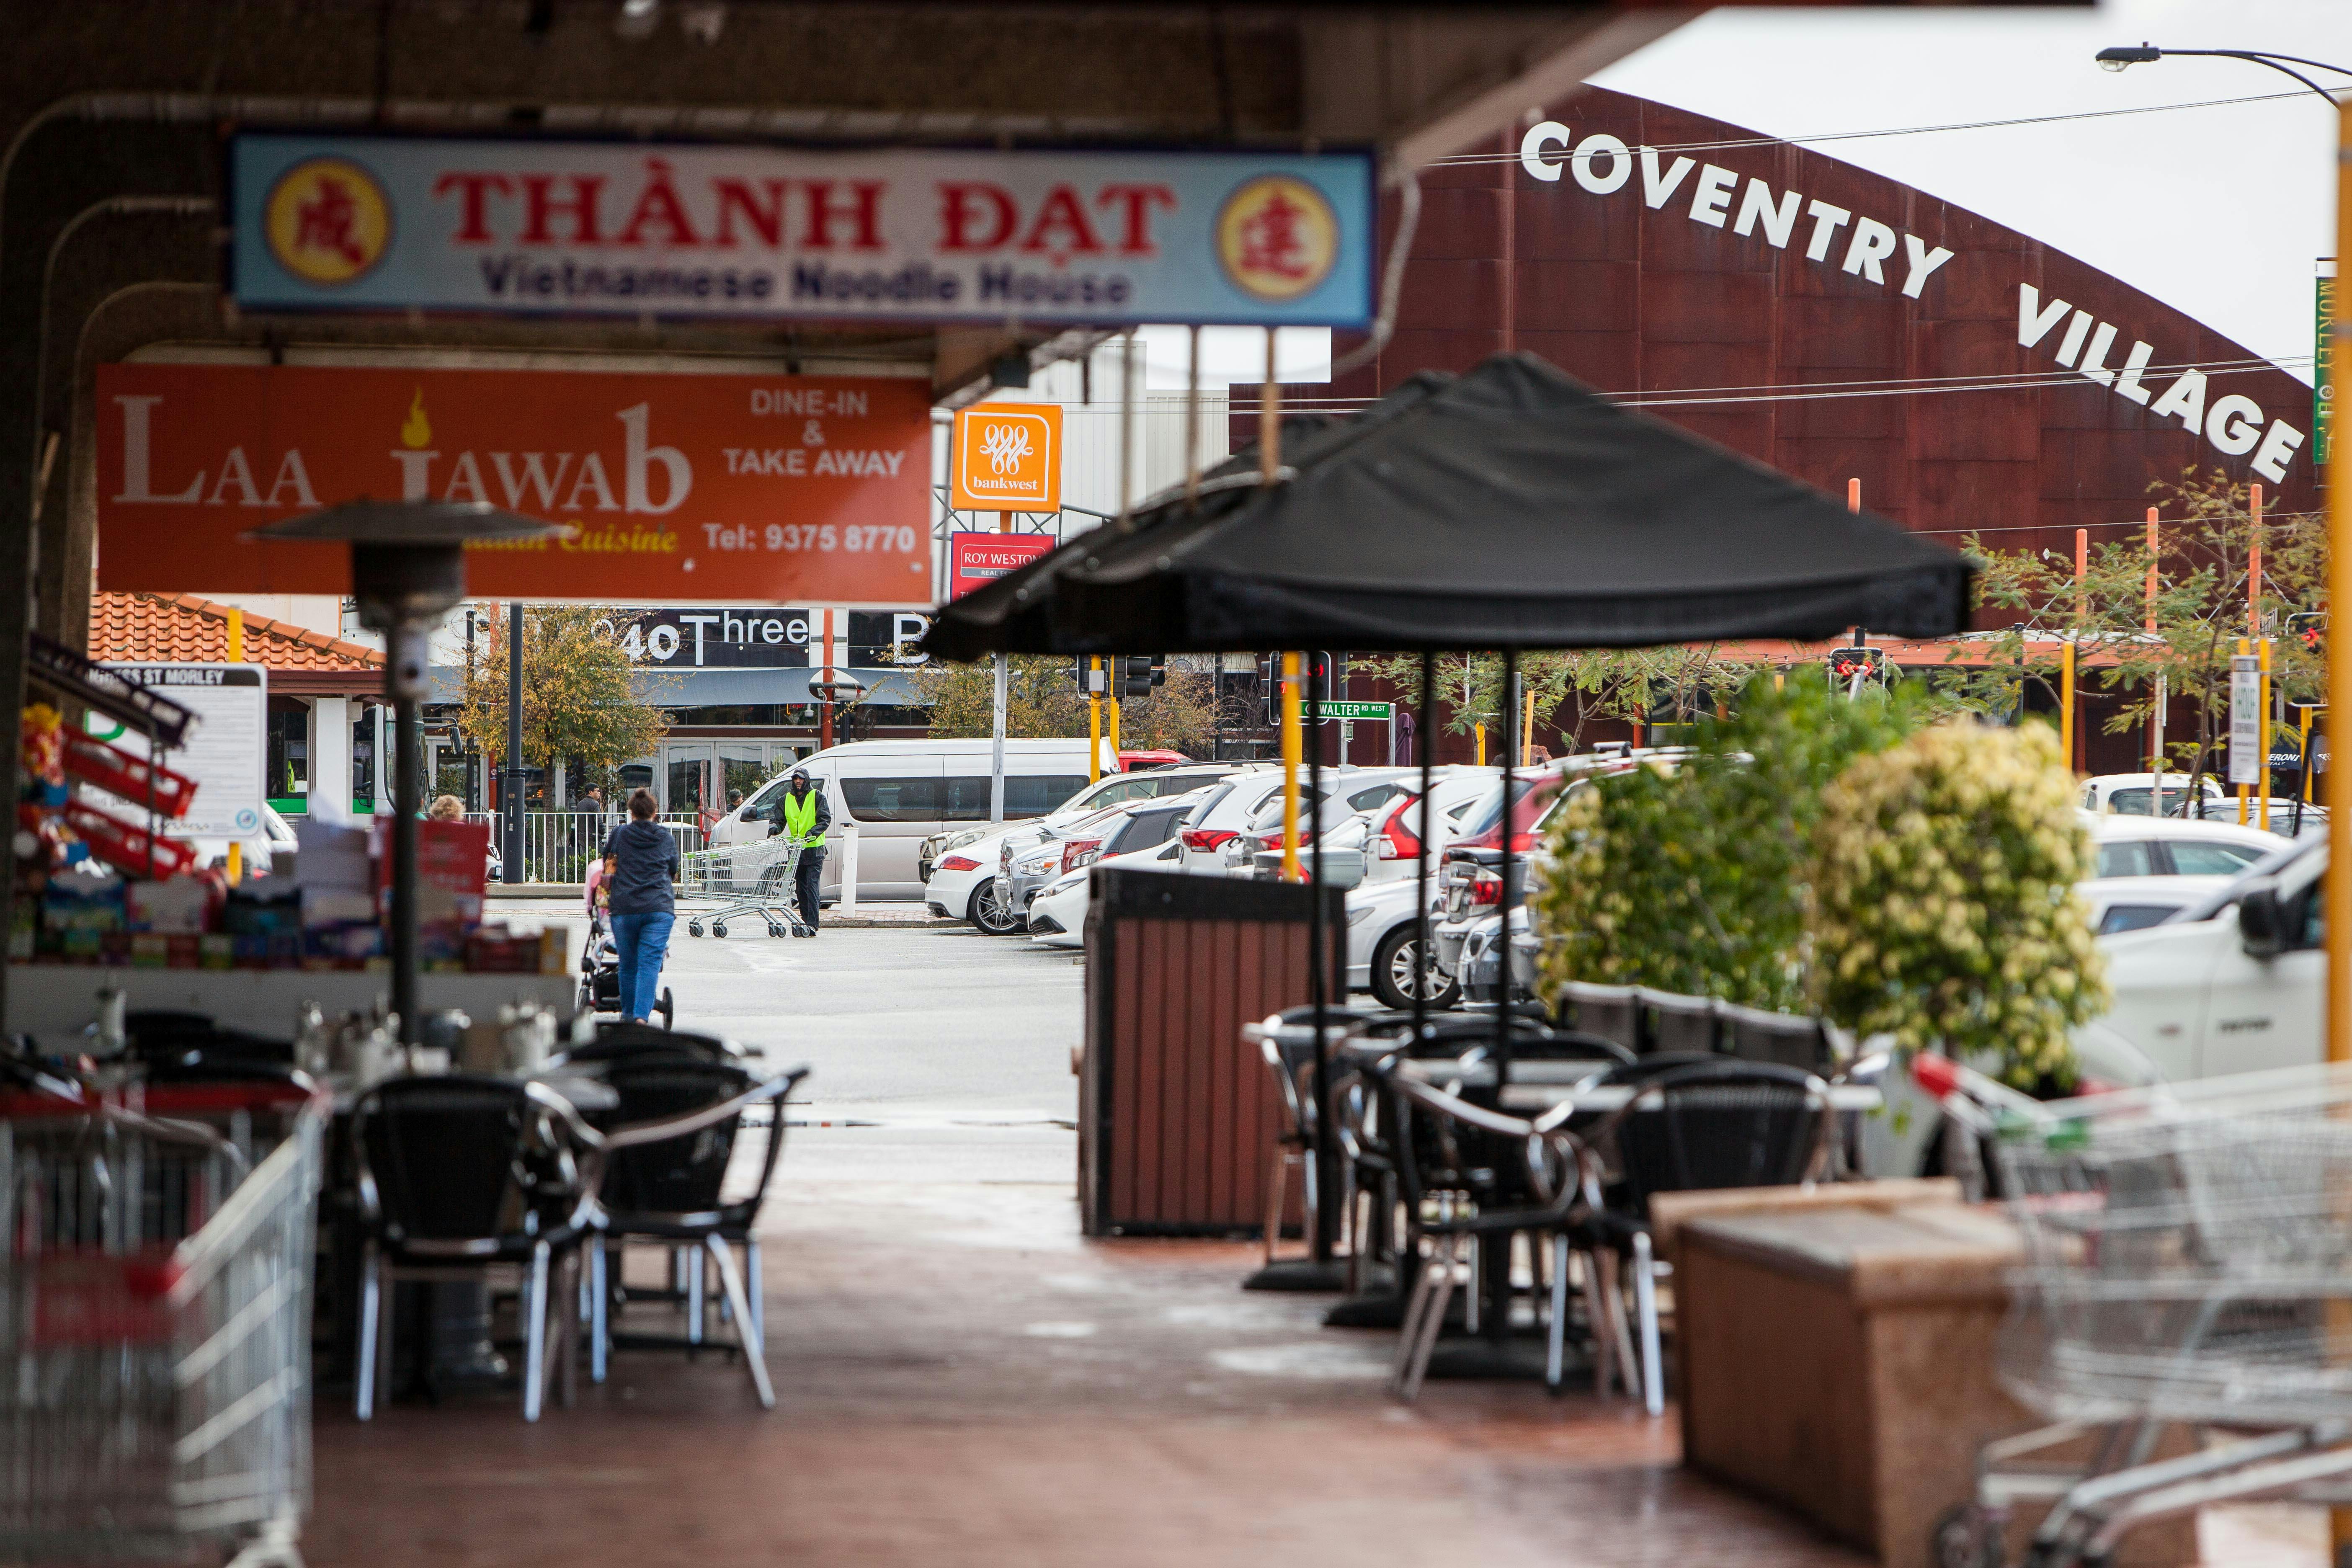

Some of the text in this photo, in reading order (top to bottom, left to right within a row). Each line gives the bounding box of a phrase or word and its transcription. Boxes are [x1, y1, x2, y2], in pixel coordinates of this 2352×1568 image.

[433, 156, 1178, 269] THÀNH ĐẠT
[1521, 121, 1954, 299] COVENTRY
[481, 255, 1131, 303] Vietnamese Noodle House
[2018, 283, 2305, 484] VILLAGE
[751, 389, 868, 415] DINE-IN
[802, 420, 825, 446] &
[112, 395, 323, 507] LAA
[722, 448, 905, 477] TAKE AWAY
[973, 476, 1037, 490] bankwest
[558, 519, 678, 553] Cuisine
[701, 523, 916, 552] Tel: 9375 8770
[964, 552, 988, 564] ROY
[143, 669, 163, 684] ST
[165, 670, 224, 684] MORLEY
[1319, 704, 1360, 716] WALTER
